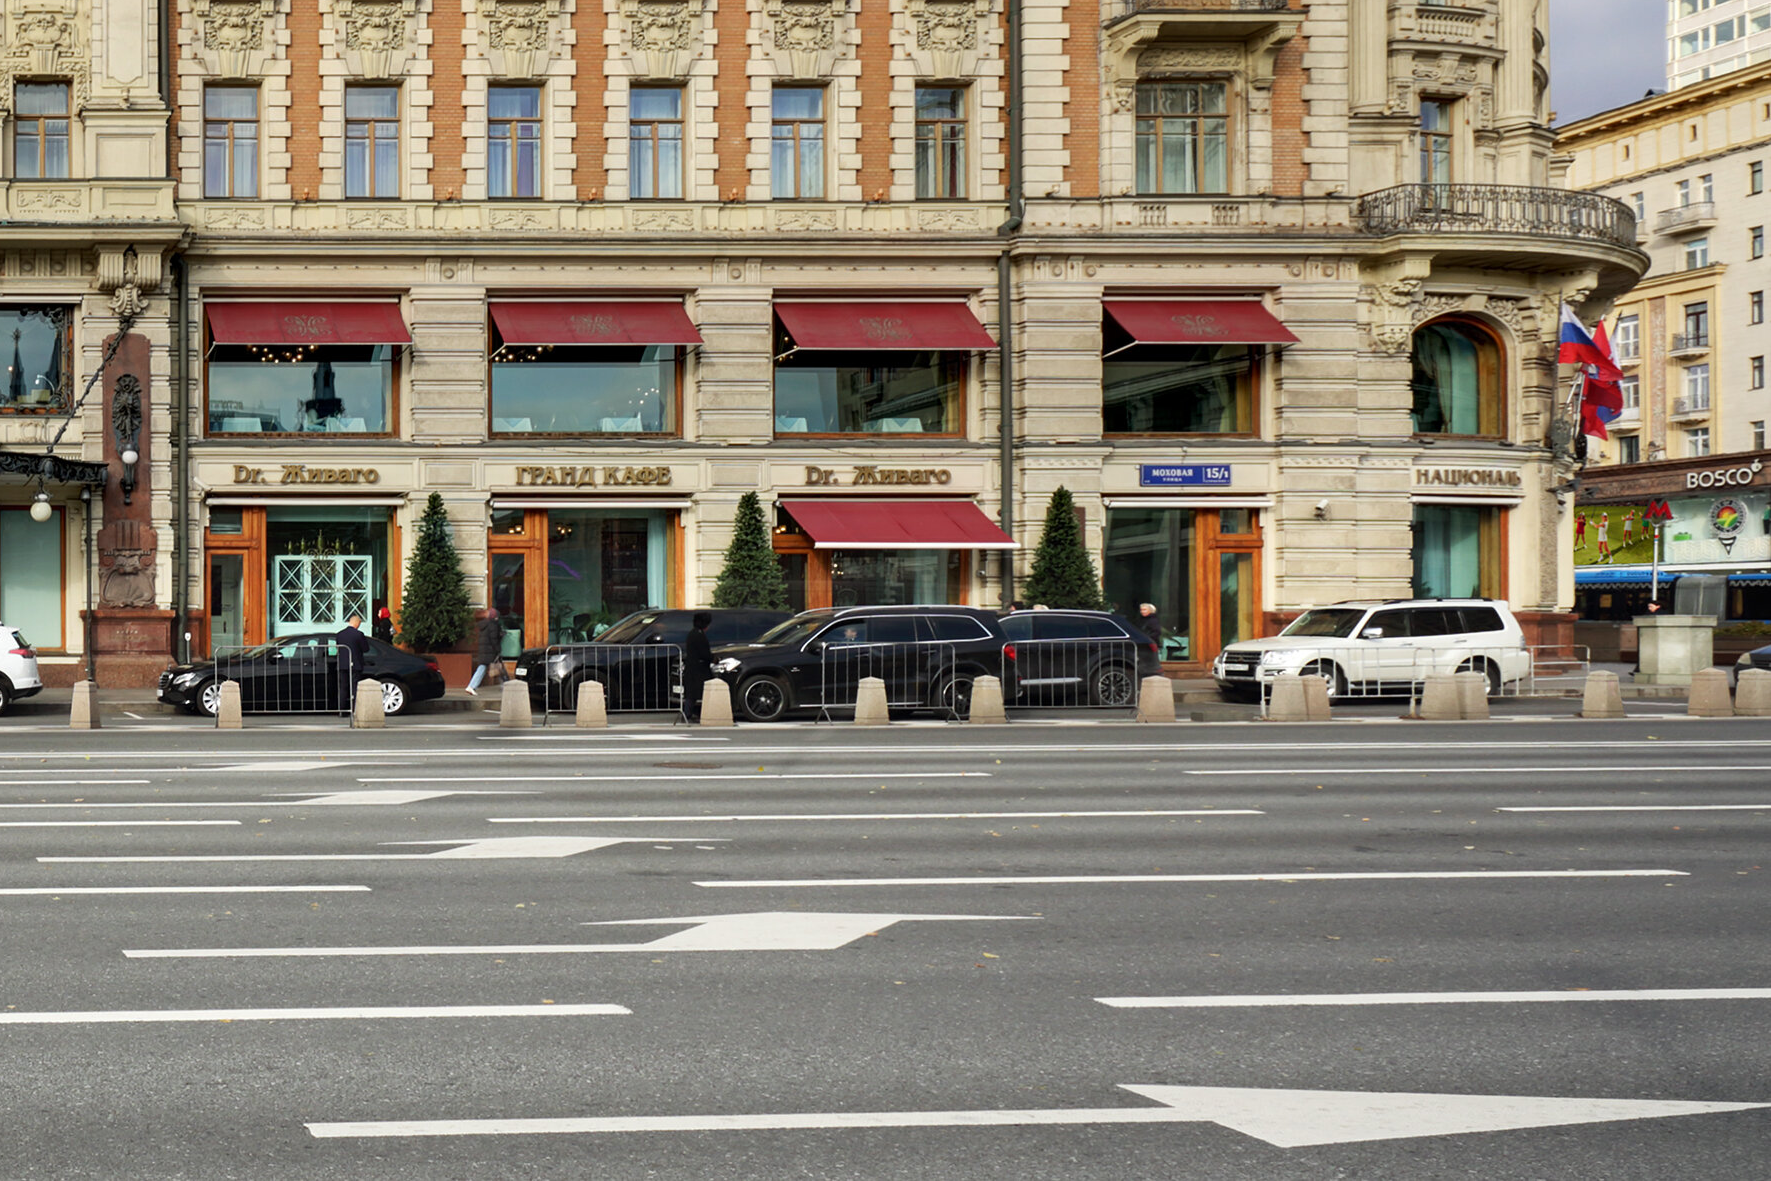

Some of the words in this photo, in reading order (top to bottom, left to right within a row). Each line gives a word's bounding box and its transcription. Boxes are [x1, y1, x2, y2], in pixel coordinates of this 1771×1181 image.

[233, 464, 267, 484] Dr.
[280, 464, 379, 485] Живаго
[515, 466, 597, 489] ГРАНД
[602, 466, 672, 486] КАФЕ
[805, 466, 838, 486] Dr.
[852, 465, 951, 486] Живаго
[1152, 469, 1193, 477] МОХОВАЯ
[1416, 469, 1521, 487] НАЦИОНАЛЬ
[1686, 468, 1753, 489] BOSCO
